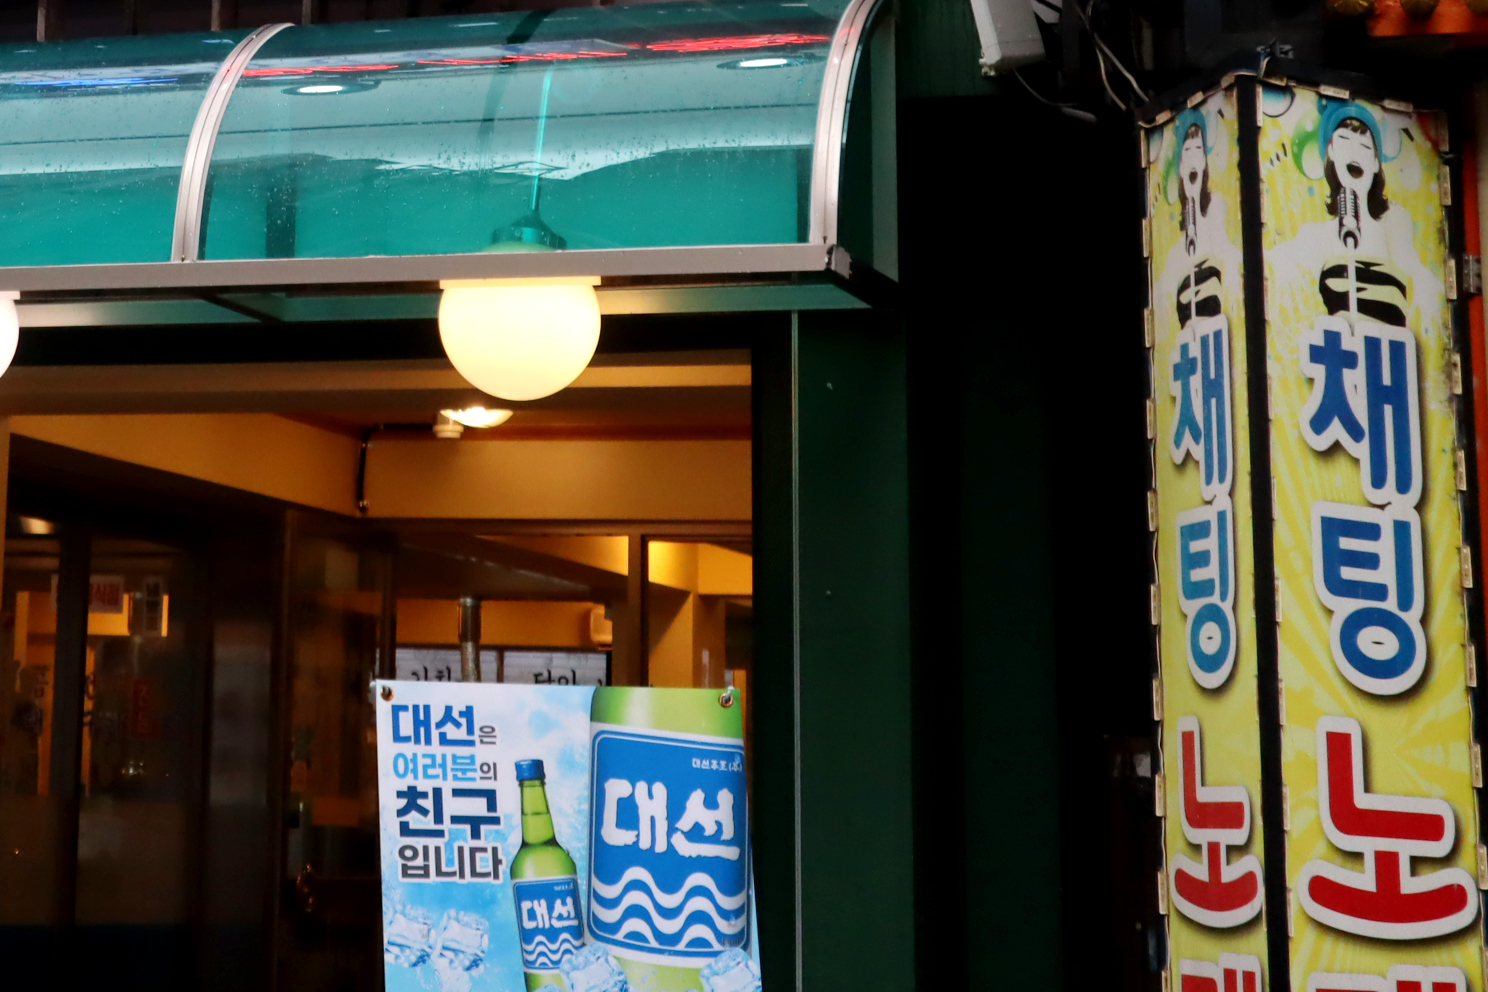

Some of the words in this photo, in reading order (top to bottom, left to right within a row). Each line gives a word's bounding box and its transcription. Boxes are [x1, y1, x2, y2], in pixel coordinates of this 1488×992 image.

[1172, 328, 1231, 675] 채팅
[1308, 340, 1416, 681] 채팅
[391, 704, 498, 748] 대선은
[392, 751, 499, 783] 여러분의
[395, 784, 502, 842] 친구
[601, 777, 742, 862] 대선
[397, 843, 504, 881] 입니다
[520, 896, 579, 930] 대선
